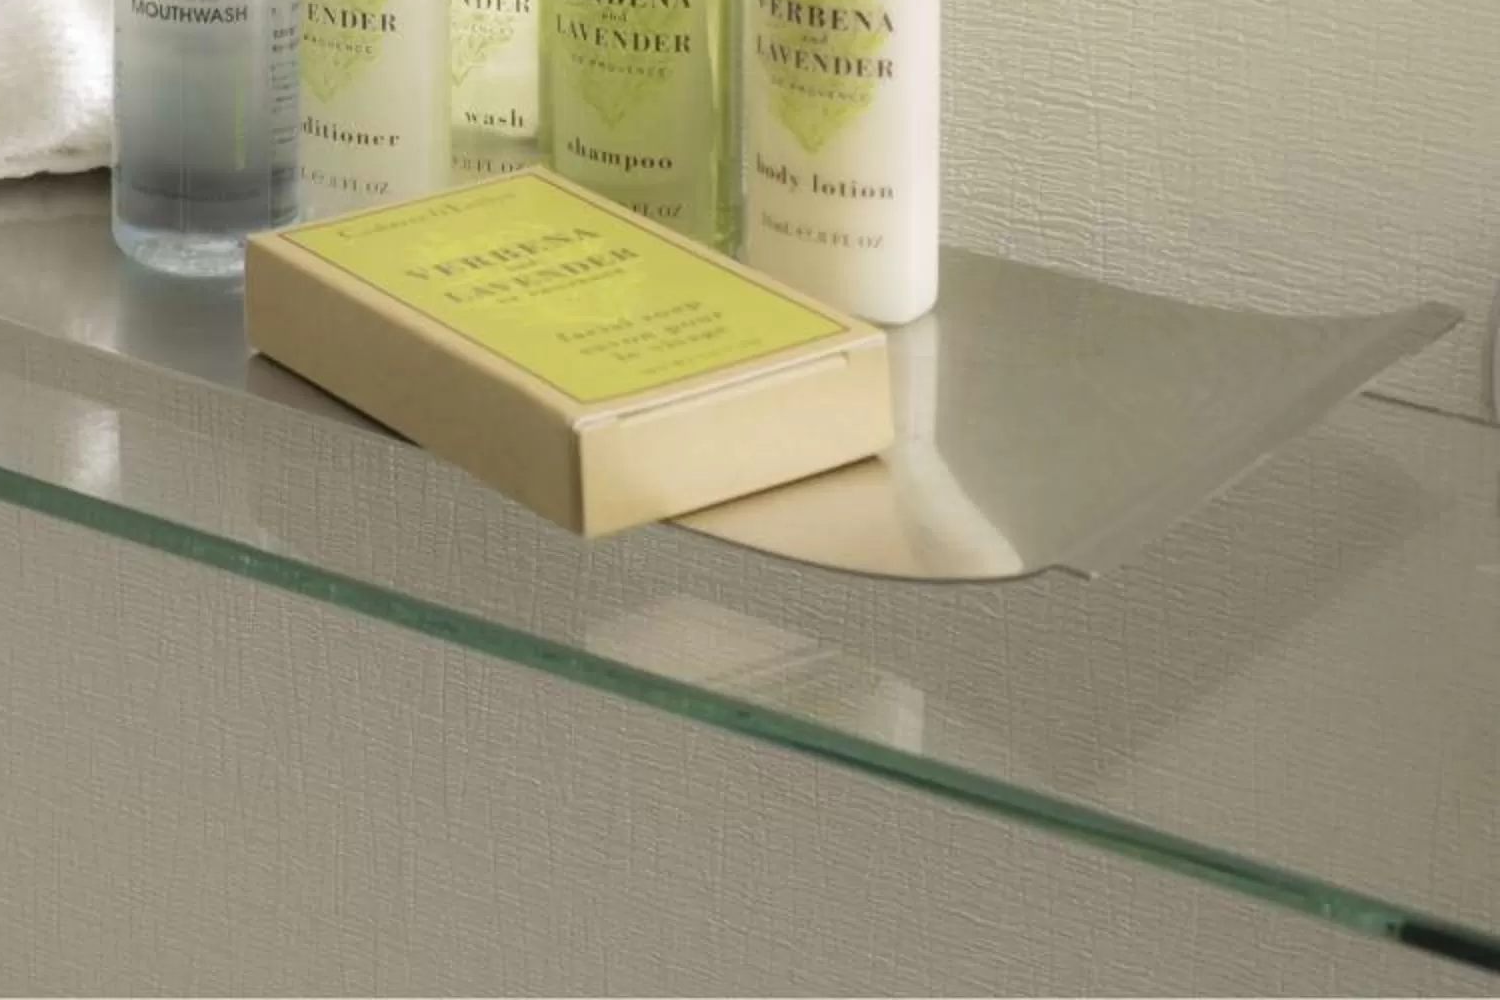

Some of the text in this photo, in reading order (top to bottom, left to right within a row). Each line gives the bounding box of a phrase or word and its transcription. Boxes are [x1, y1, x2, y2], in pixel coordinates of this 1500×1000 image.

[307, 2, 398, 32] ENDER
[555, 12, 692, 53] LAVENDER
[756, 34, 895, 78] LAVENDER
[302, 115, 401, 148] ditioner
[463, 107, 526, 129] wash
[566, 135, 674, 173] shampoo
[756, 151, 895, 200] body lotion
[404, 227, 602, 281] VERBENA
[443, 247, 641, 305] LAVENDER
